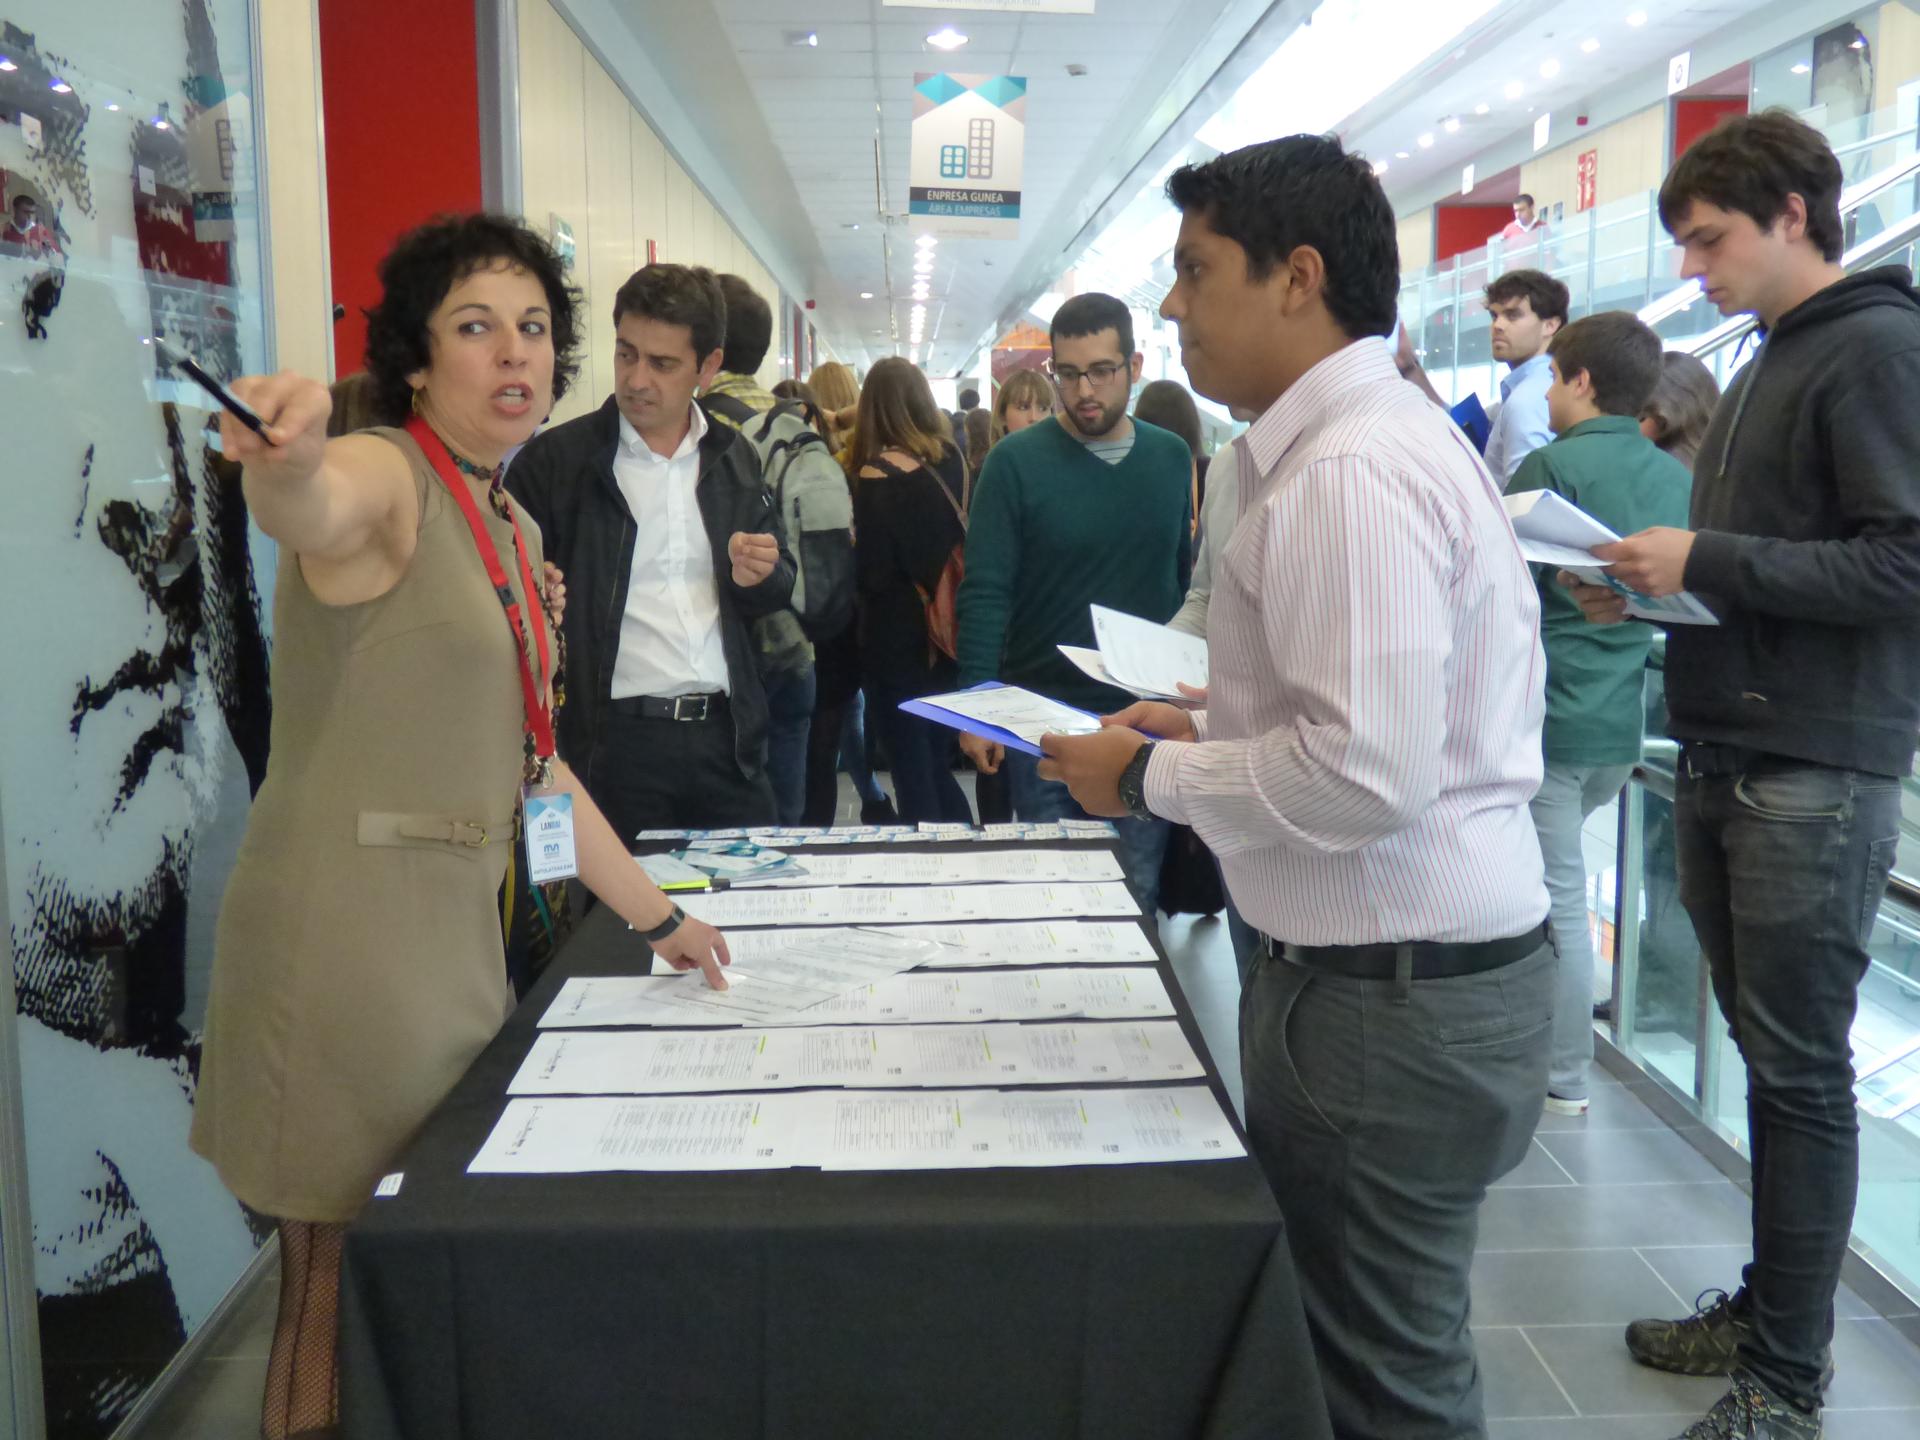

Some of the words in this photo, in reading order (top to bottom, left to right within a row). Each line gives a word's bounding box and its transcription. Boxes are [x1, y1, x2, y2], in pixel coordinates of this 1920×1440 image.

[927, 190, 968, 201] ENPRESA
[970, 191, 1004, 203] GUNEA
[954, 204, 1001, 217] EMPRESAS
